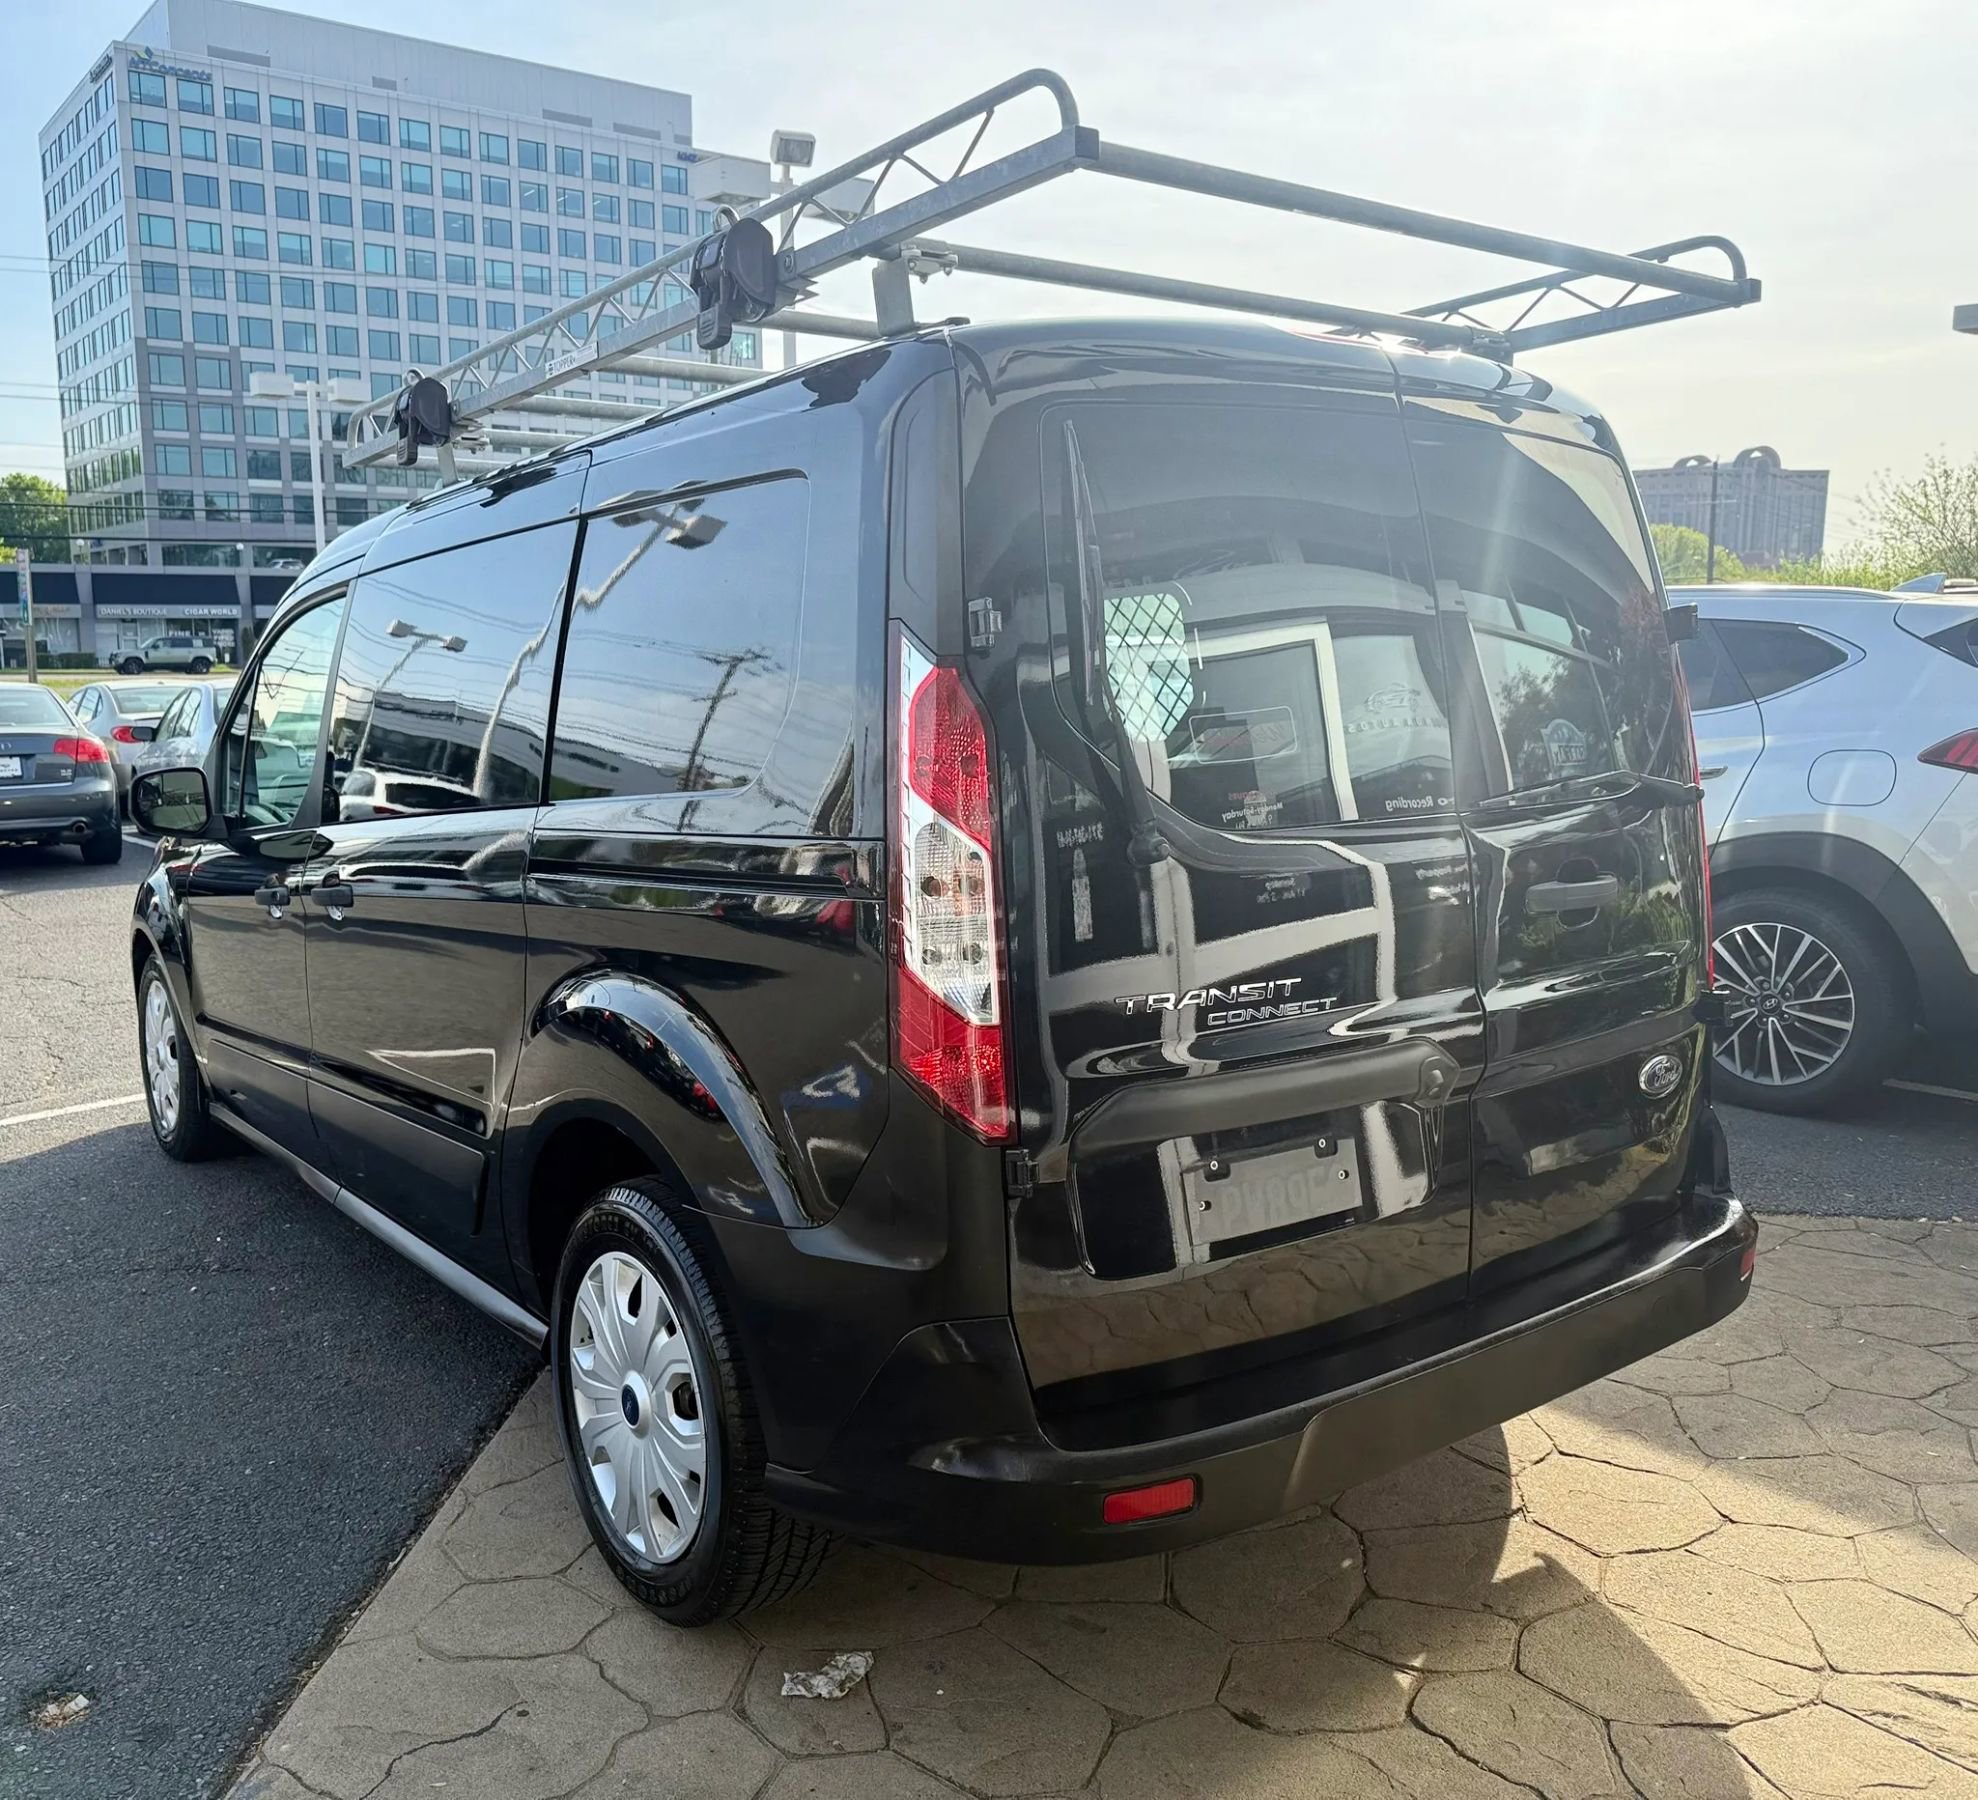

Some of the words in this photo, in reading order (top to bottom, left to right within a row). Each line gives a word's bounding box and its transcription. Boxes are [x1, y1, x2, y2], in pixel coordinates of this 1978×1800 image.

[184, 607, 209, 616] CIGAR
[209, 608, 238, 616] WORLD
[1115, 977, 1302, 1015] TRANSIT
[1207, 997, 1338, 1026] CONNECT
